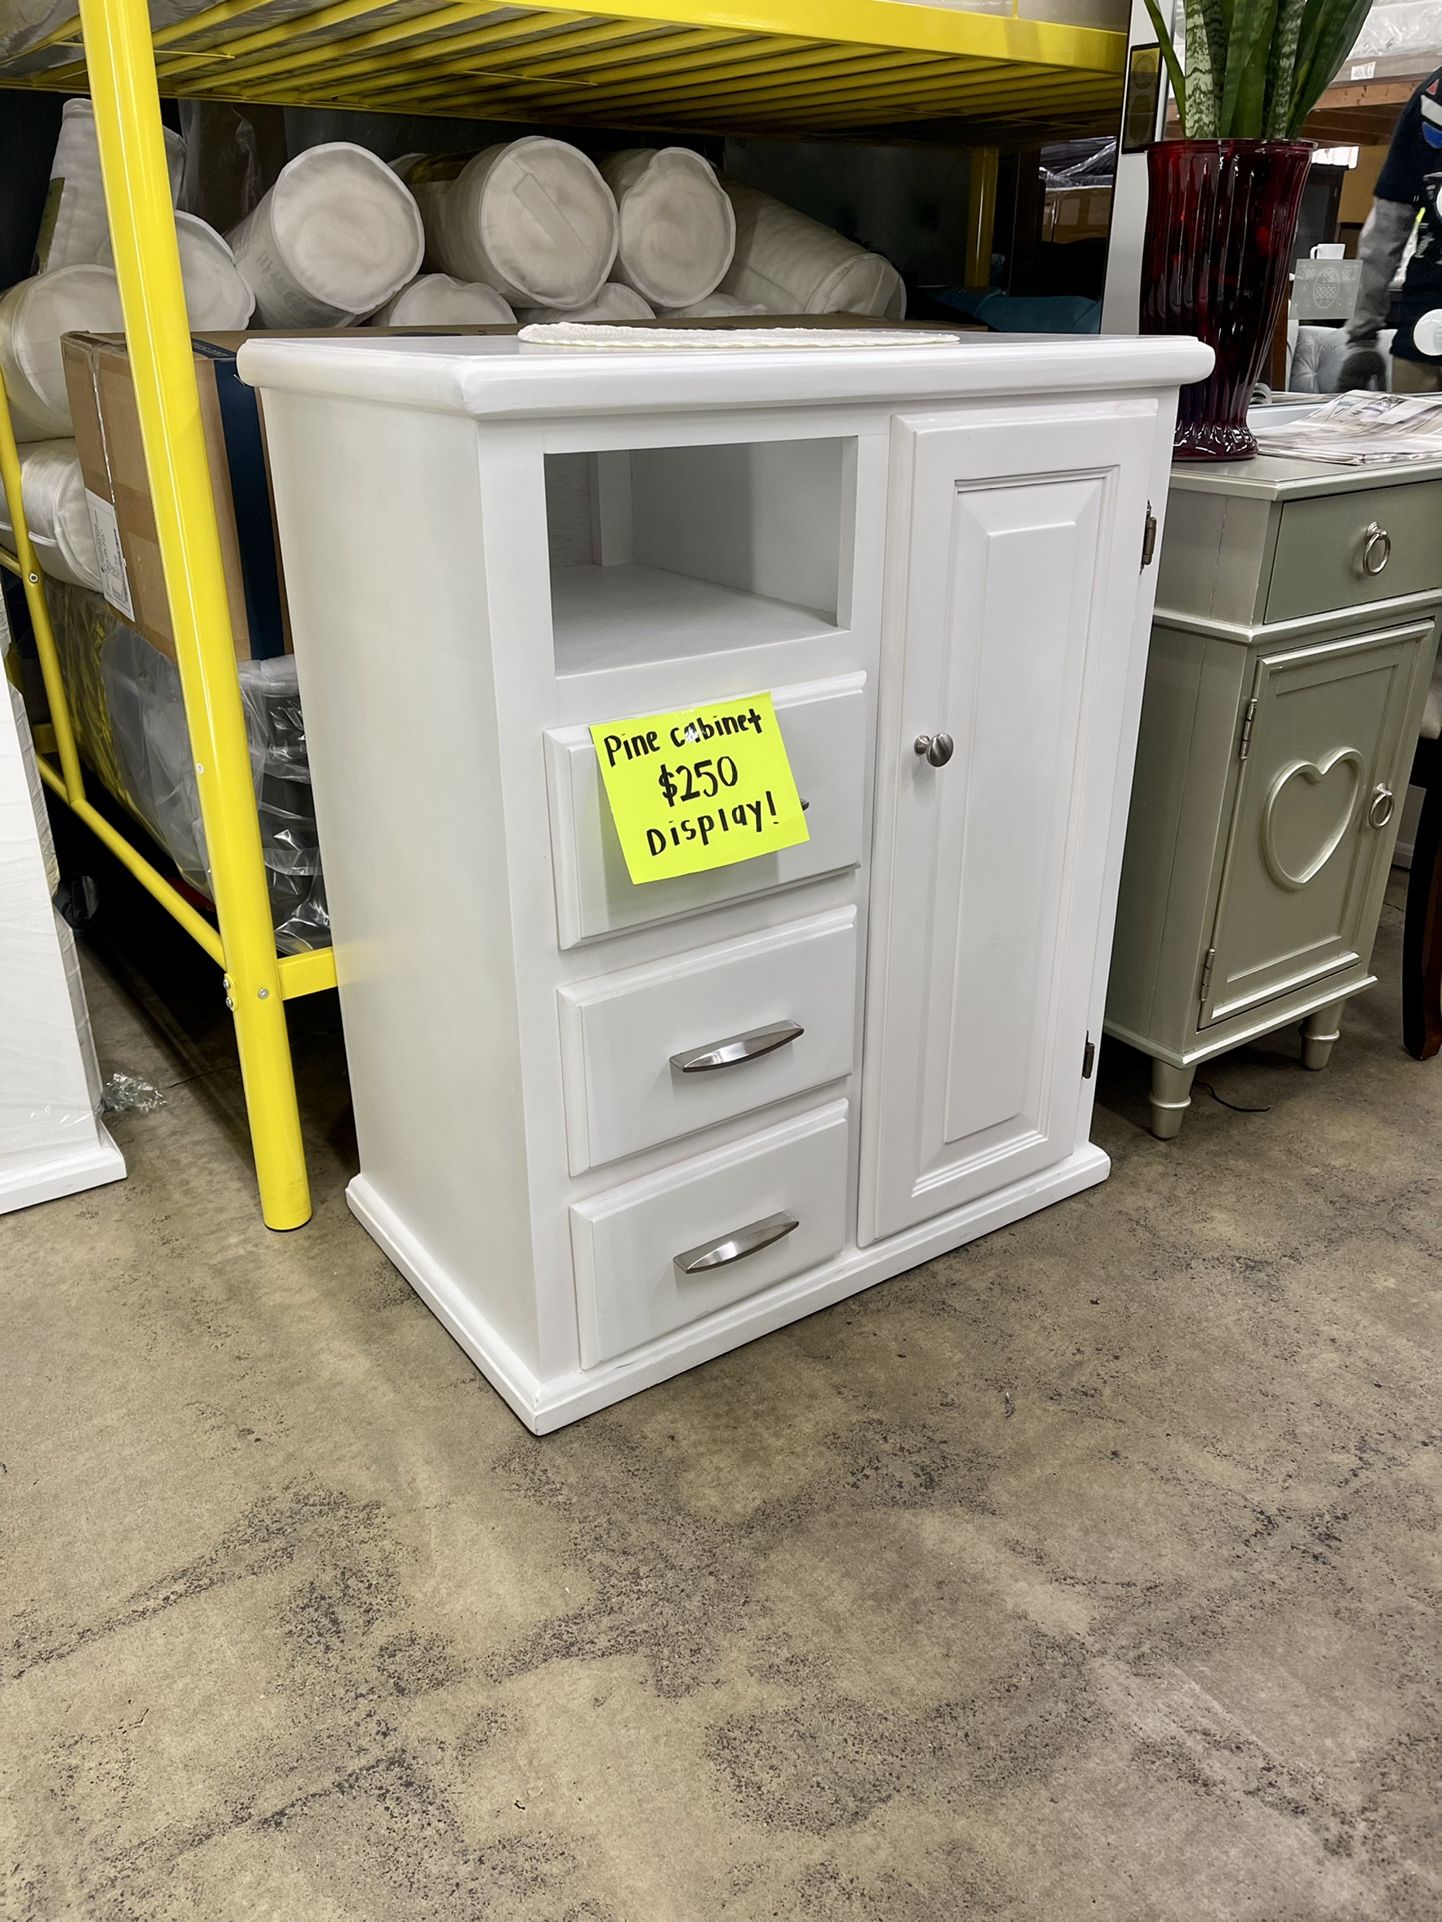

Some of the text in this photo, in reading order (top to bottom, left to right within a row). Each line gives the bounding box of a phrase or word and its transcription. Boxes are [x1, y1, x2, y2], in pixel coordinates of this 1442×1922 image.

[603, 731, 660, 767] Pine
[658, 756, 738, 807] $250
[646, 791, 779, 856] Display!
